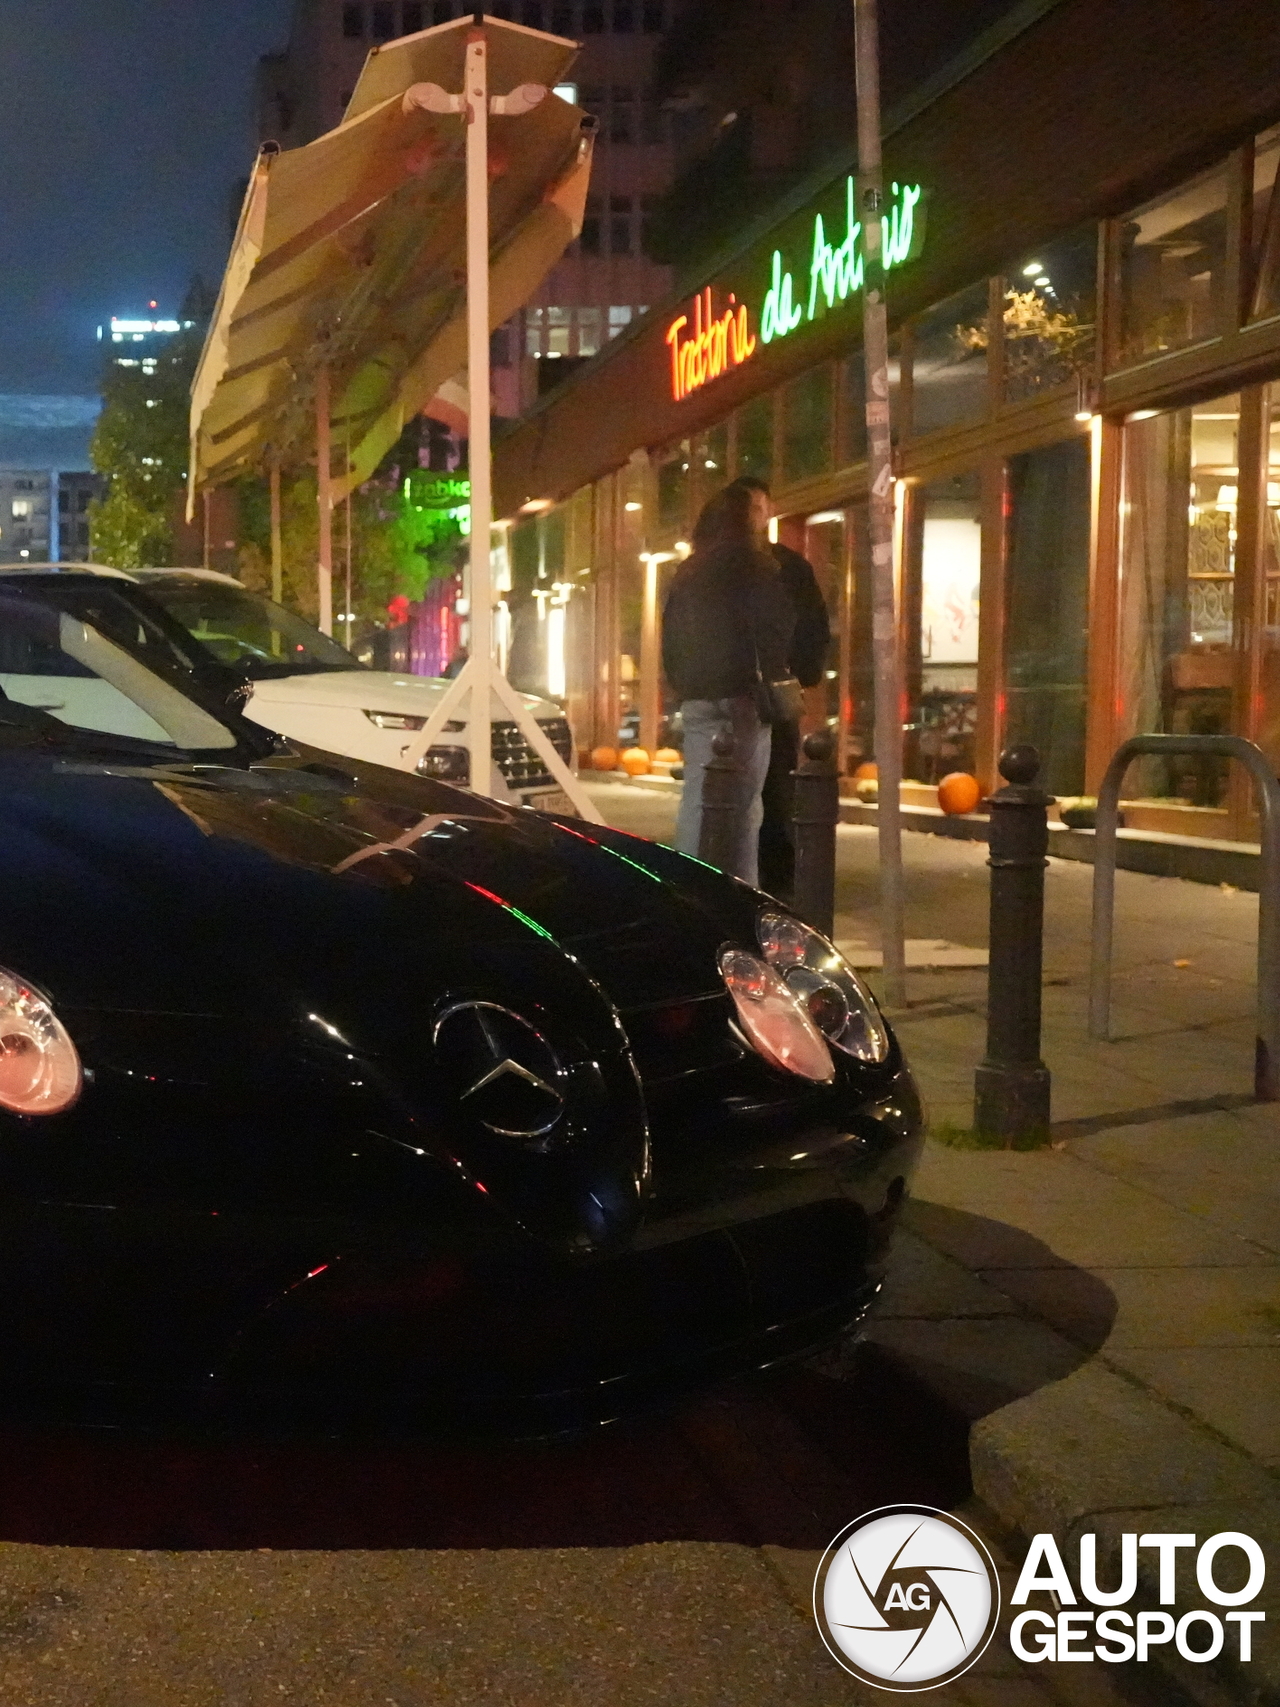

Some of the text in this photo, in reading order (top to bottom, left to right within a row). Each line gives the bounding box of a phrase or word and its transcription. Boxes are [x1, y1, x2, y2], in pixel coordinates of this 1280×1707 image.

[666, 175, 921, 401] Trattoria da Antio
